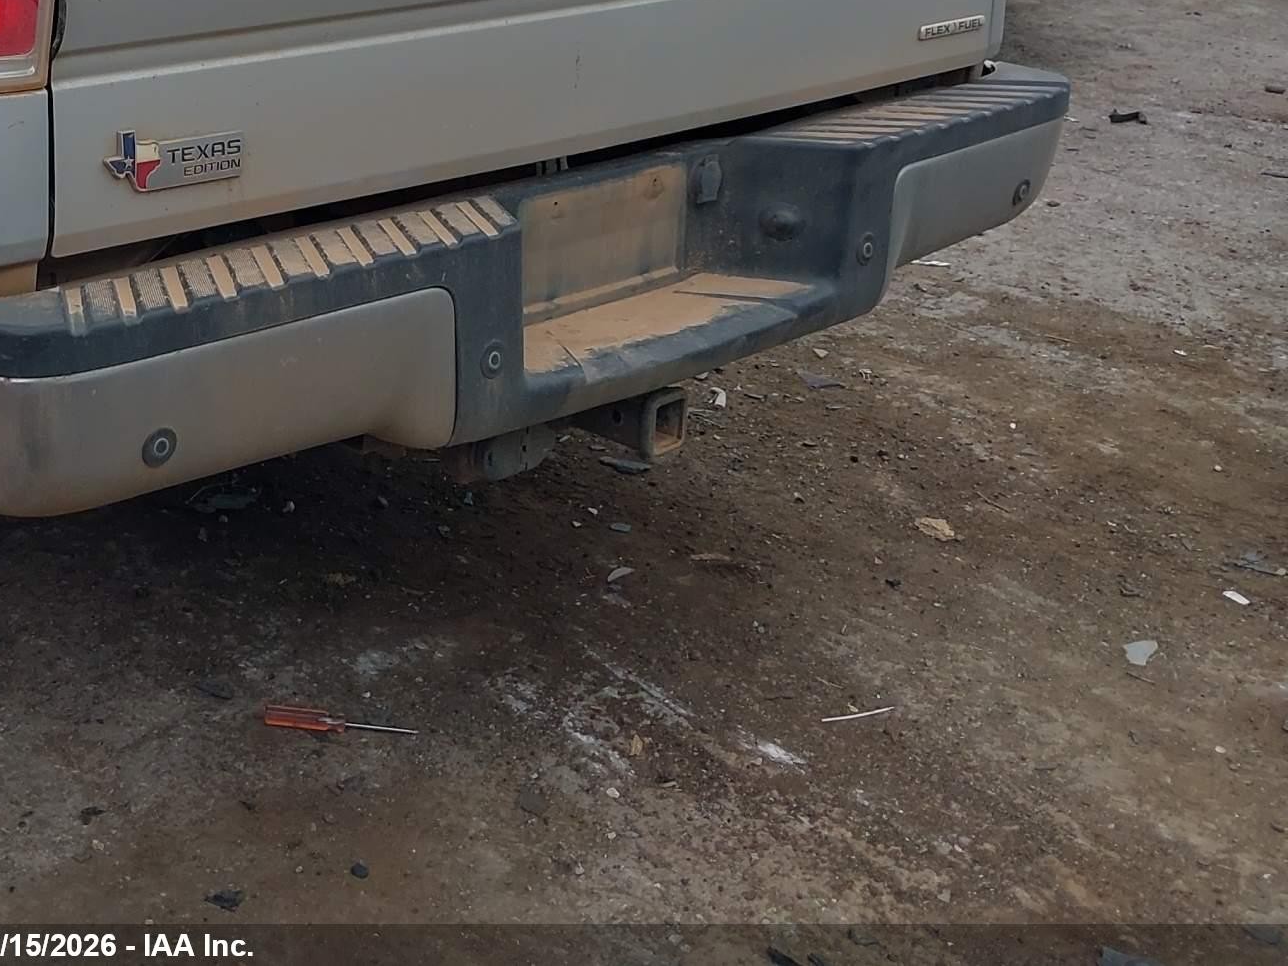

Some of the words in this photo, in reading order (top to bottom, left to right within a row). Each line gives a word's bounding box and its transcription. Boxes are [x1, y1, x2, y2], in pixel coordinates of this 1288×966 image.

[925, 23, 951, 37] FLEX
[958, 17, 983, 31] FUEL
[167, 139, 241, 164] TEXAS
[183, 158, 241, 177] EDITION
